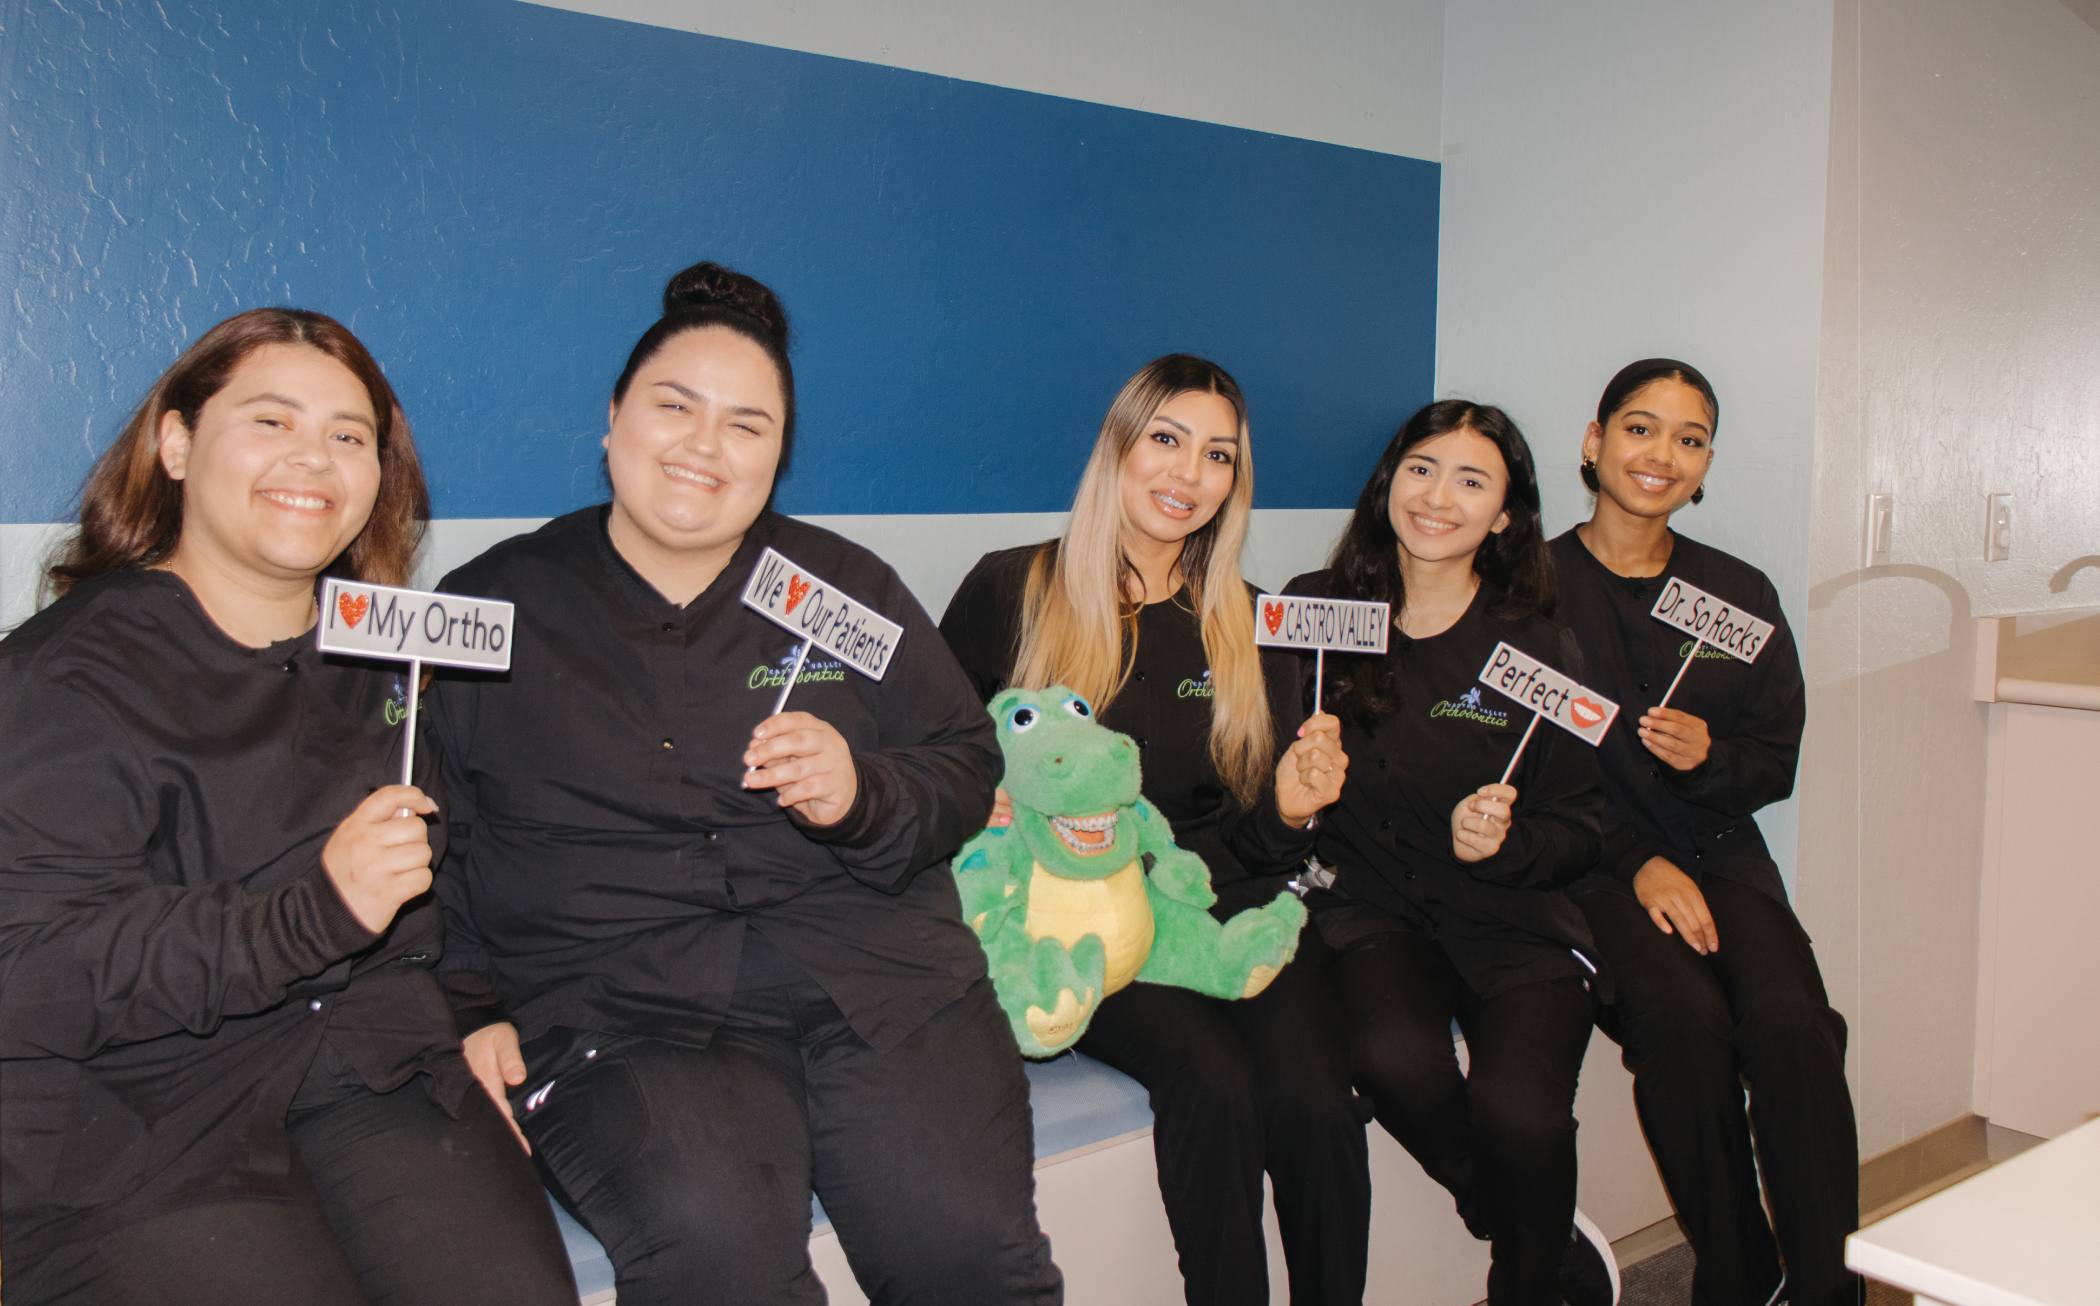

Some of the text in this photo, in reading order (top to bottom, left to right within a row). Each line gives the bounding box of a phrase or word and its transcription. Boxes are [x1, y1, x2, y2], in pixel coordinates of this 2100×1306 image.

[329, 585, 505, 652] I My Ortho
[753, 555, 889, 672] We Our Patients
[1657, 582, 1761, 657] Dr. So Rocks
[748, 664, 845, 689] Orthdontics
[1486, 648, 1569, 717] Perfect
[1430, 699, 1508, 727] Orthodontics
